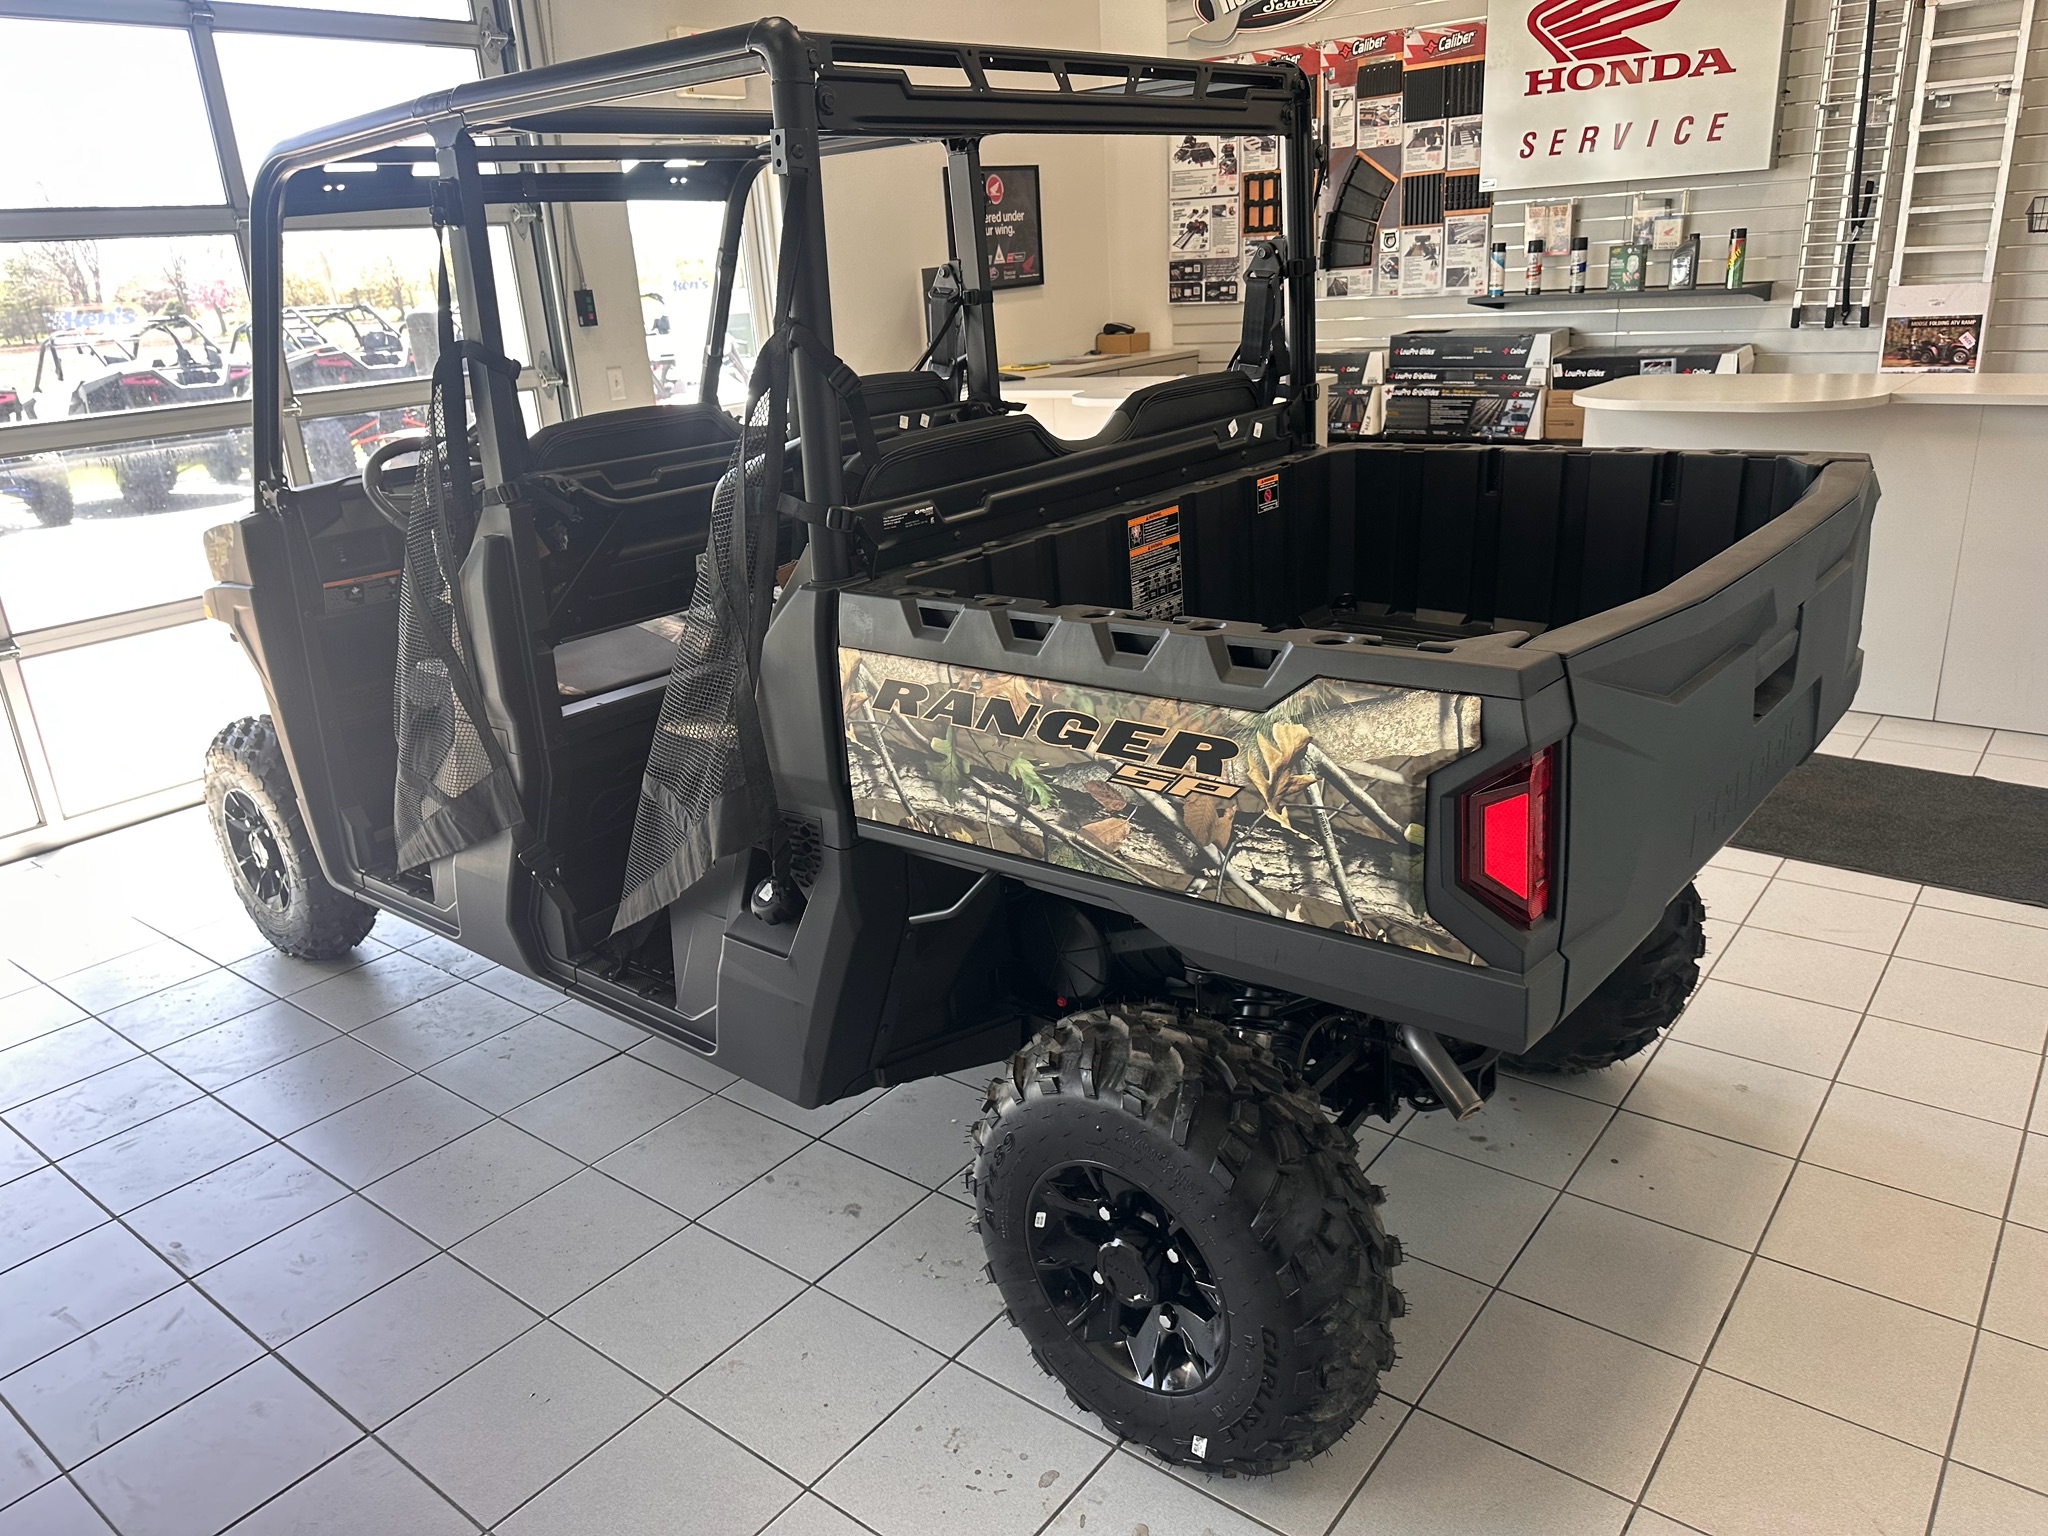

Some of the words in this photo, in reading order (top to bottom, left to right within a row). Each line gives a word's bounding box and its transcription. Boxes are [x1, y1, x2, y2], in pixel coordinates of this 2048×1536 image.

[1352, 36, 1386, 55] Caliber
[1438, 31, 1475, 51] Caliber
[1524, 48, 1737, 97] HONDA
[1519, 112, 1729, 159] SERVICE
[1003, 210, 1024, 222] under
[995, 224, 1015, 237] wing.
[1400, 347, 1419, 356] LowPro
[1419, 347, 1436, 356] Glides
[1510, 347, 1527, 355] Caliber
[1394, 372, 1413, 380] LowPro
[1564, 369, 1587, 378] LowPro
[1587, 369, 1607, 378] Glides
[1392, 388, 1412, 396] LowPro
[871, 678, 1241, 779] RANGER
[1105, 763, 1245, 800] SP
[1218, 1325, 1278, 1444] CARLISLE
